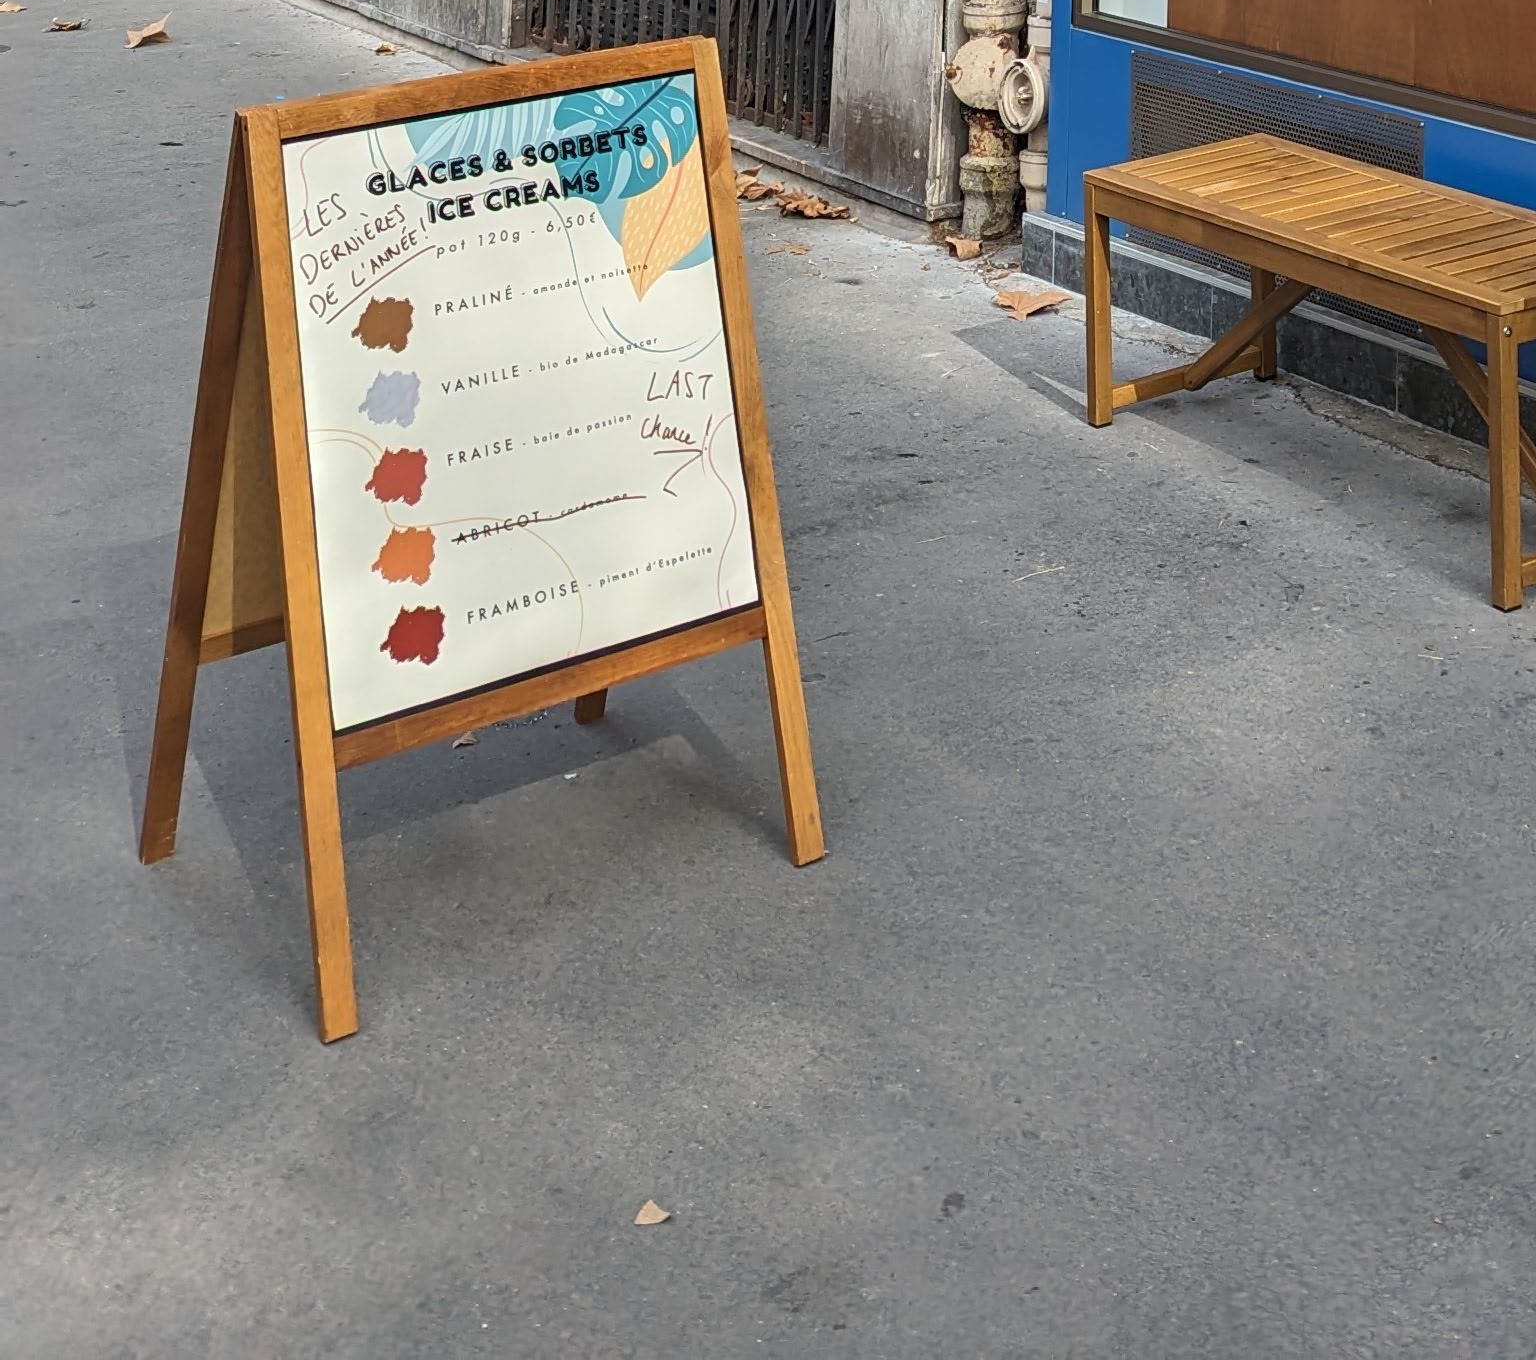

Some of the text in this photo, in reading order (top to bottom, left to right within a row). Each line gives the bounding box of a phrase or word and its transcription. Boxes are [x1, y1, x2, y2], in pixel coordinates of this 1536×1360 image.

[365, 123, 649, 197] GLACES & SORBETS
[303, 192, 347, 237] LES
[426, 169, 601, 224] ICE CREAMS
[299, 203, 406, 286] DERNIÈRES
[436, 239, 468, 259] pot
[477, 228, 522, 247] 120g
[545, 211, 597, 233] 6,50€
[434, 284, 514, 316] PRALINÉ
[600, 263, 649, 280] noisette
[441, 364, 521, 395] VANILLE
[539, 360, 559, 373] bio
[565, 355, 579, 366] de
[585, 336, 658, 361] Madagascar
[646, 369, 714, 402] LAST
[447, 438, 514, 467] FRAISE
[533, 431, 560, 445] baie
[566, 425, 581, 437] de
[586, 413, 632, 433] passion
[456, 510, 540, 546] ABRICOT
[467, 579, 579, 625] FRAMBOISE
[598, 567, 640, 588] piment
[645, 545, 713, 573] d'Espelette
